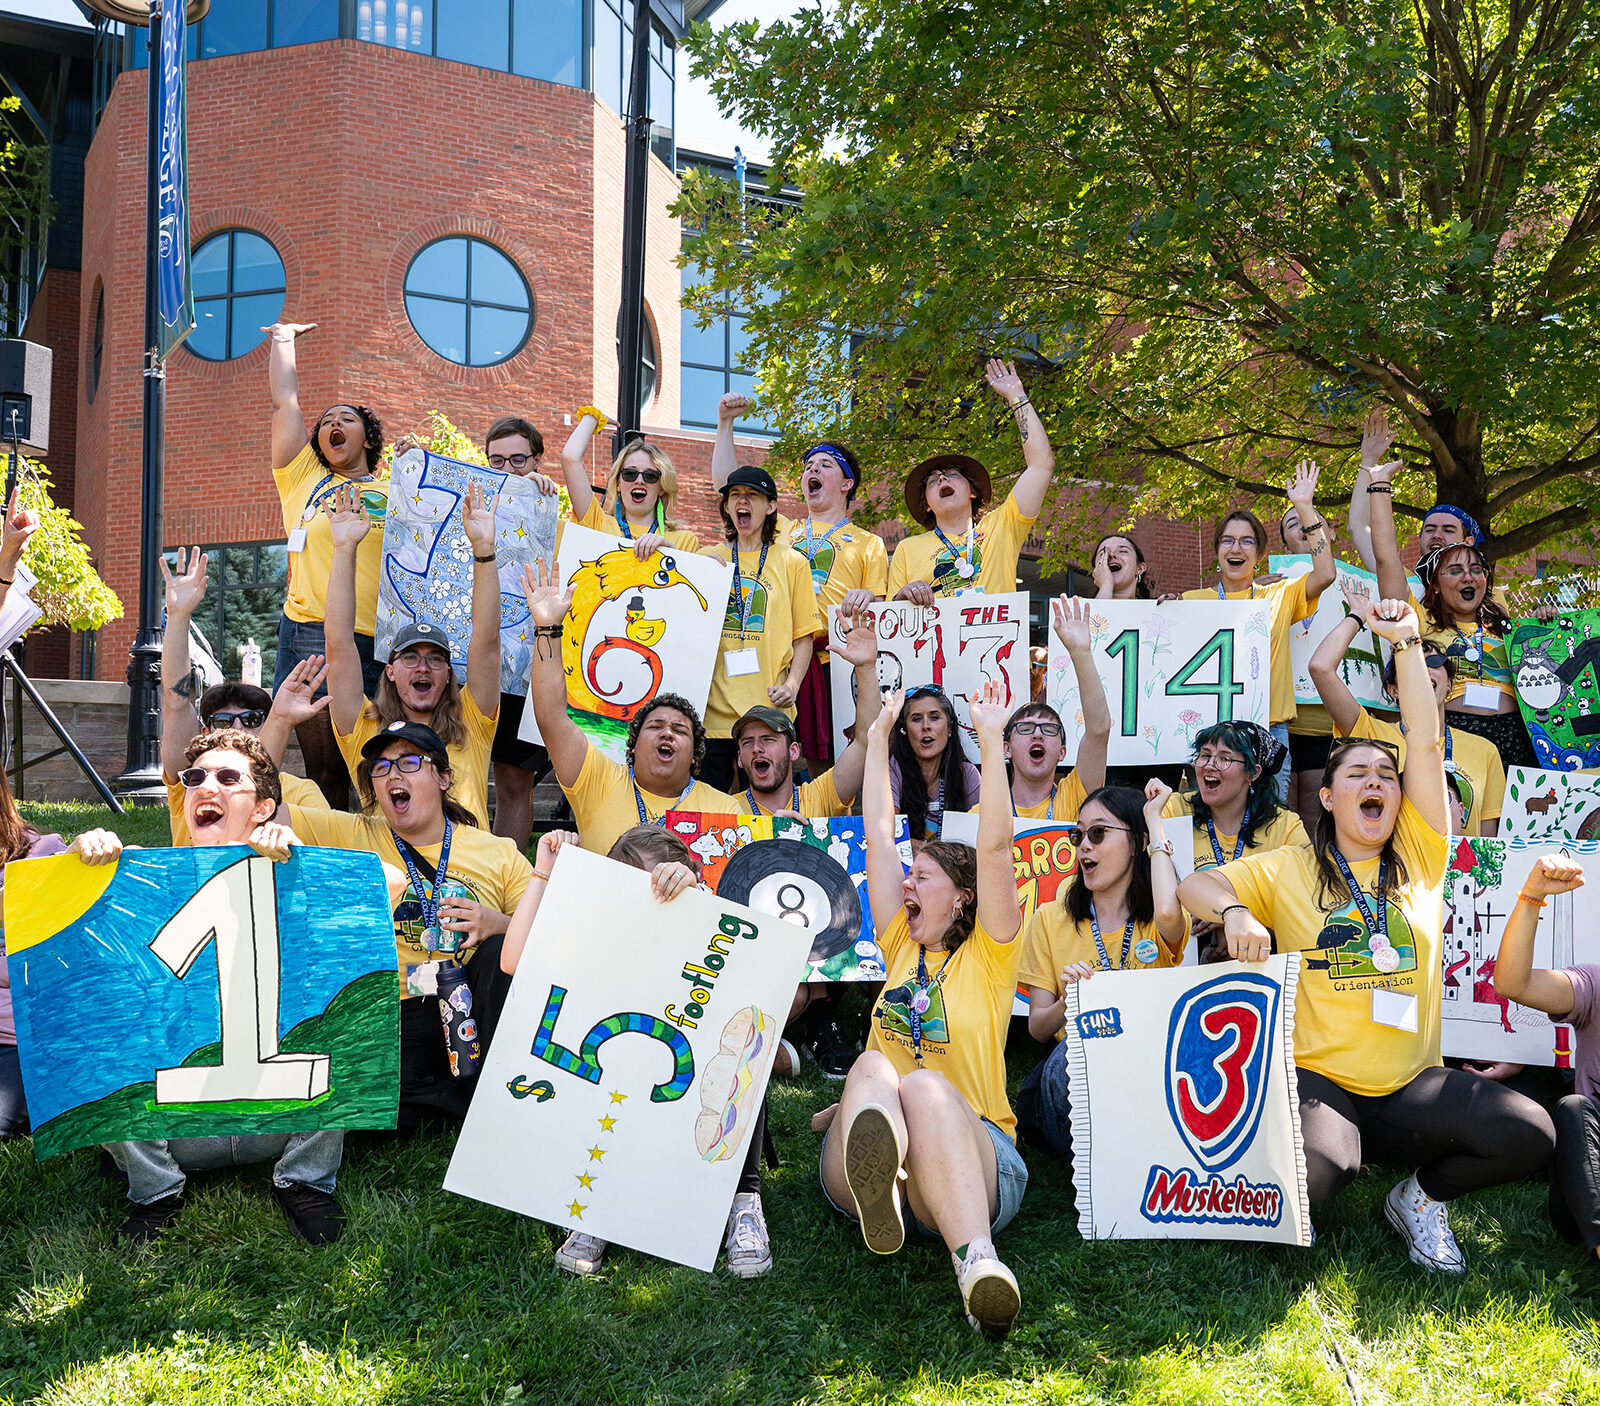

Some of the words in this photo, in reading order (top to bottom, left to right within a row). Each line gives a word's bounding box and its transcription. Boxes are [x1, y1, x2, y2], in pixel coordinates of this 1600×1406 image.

[961, 605, 1009, 625] THE
[1105, 628, 1244, 736] 14
[406, 861, 427, 901] CHAMPLAIN
[435, 858, 447, 888] COLLEGE
[1013, 836, 1077, 881] GRO
[777, 883, 809, 928] 8
[1347, 878, 1373, 918] CHAMPLAIN
[1121, 921, 1134, 958] OLLEGE
[149, 856, 330, 1104] 1
[665, 913, 759, 1030] footlong
[1334, 976, 1413, 992] Orientation
[1176, 1006, 1259, 1142] 3
[1146, 1171, 1279, 1217] Musketeers
